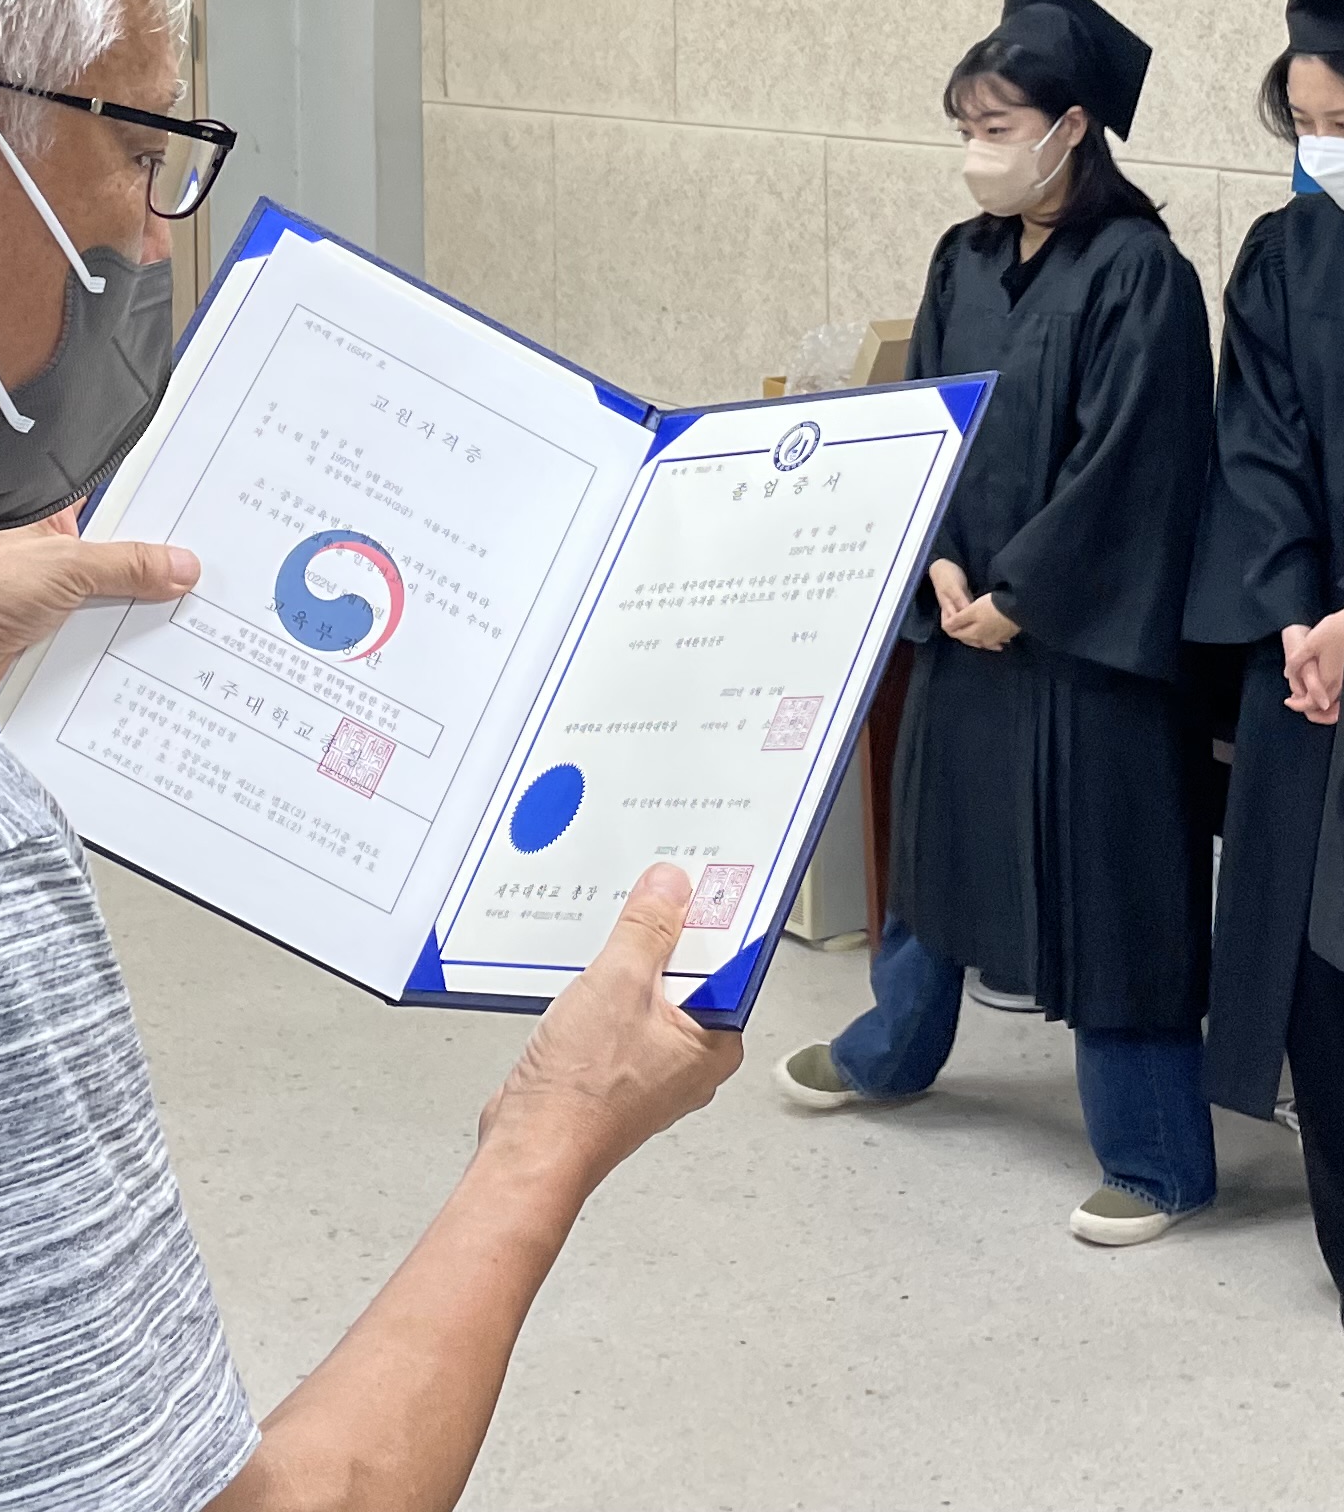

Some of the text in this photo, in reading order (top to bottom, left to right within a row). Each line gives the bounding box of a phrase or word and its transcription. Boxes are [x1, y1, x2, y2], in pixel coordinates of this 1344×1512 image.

[303, 319, 332, 340] 제주대
[345, 342, 373, 361] 16547
[370, 394, 481, 463] 교원자격증
[323, 463, 362, 489] 중등학교
[329, 450, 403, 496] 1997년 9월 20일
[731, 471, 841, 501] 졸업증서
[237, 491, 263, 511] 위의
[267, 507, 305, 533] 자격이
[402, 582, 419, 595] 이
[424, 590, 459, 617] 증서를
[466, 613, 502, 639] 수여함
[400, 554, 490, 609] 자격기준에 따라
[188, 617, 217, 638] 제22조
[220, 634, 246, 652] 제2항
[248, 648, 283, 672] 제2호에
[238, 626, 287, 658] 행정권한의
[289, 653, 310, 671] 위임
[312, 664, 323, 678] 및
[262, 588, 386, 675] 교육부장관
[170, 722, 211, 749] 자격기준
[232, 791, 261, 812] 제21조
[306, 830, 346, 857] 자격기준
[235, 777, 265, 798] 제21조
[310, 816, 350, 844] 자격기준
[495, 882, 598, 901] 제주대학교 총장
